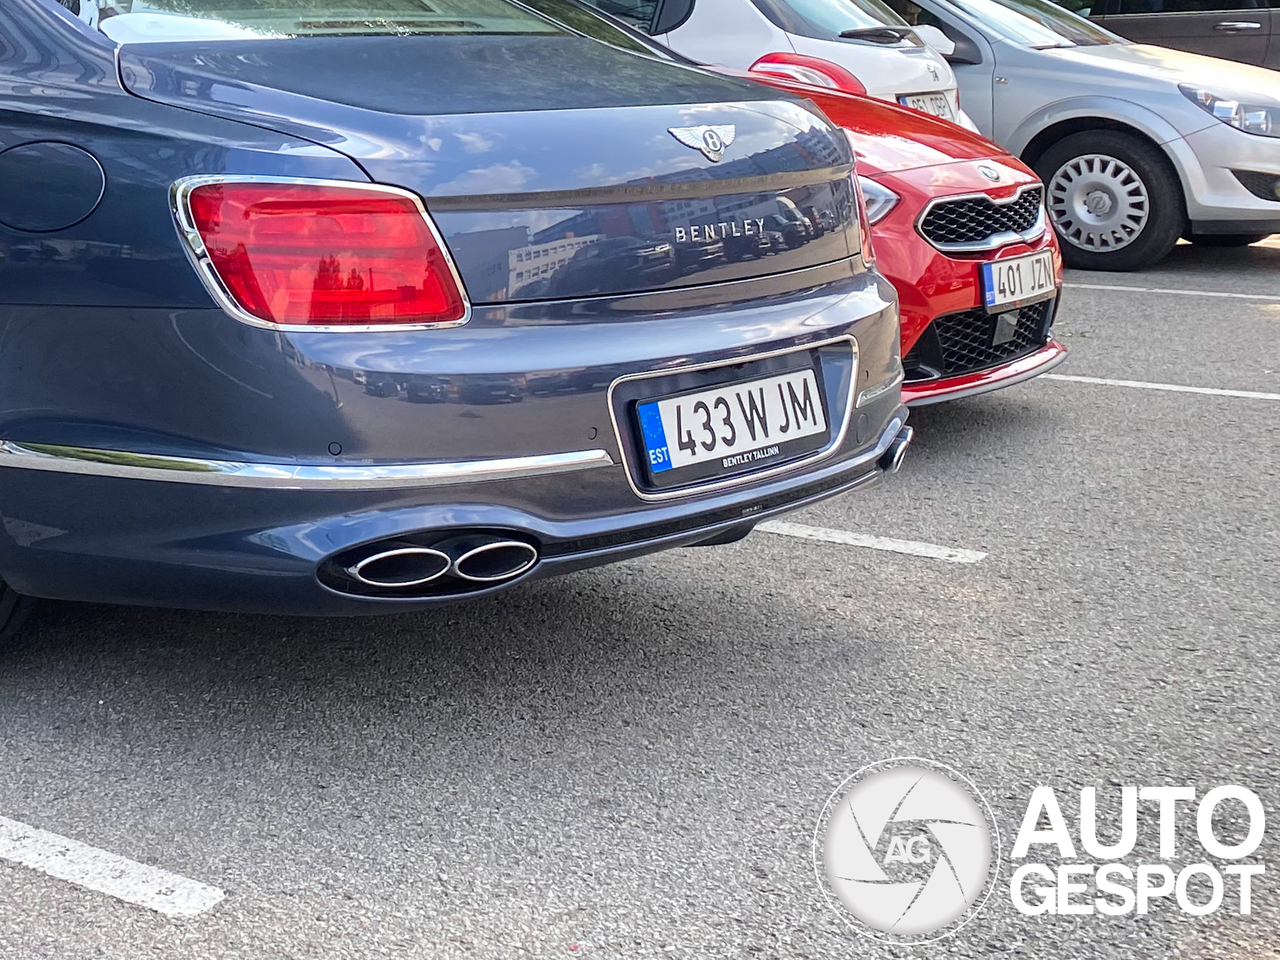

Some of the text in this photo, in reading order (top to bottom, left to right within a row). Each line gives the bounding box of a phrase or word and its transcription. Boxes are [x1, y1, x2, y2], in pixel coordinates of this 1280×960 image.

[675, 218, 764, 243] BENTLEY
[998, 255, 1052, 298] 401 JZN
[676, 396, 736, 456] 433
[648, 446, 668, 465] EST
[722, 445, 780, 468] BENTLEY TALLINN
